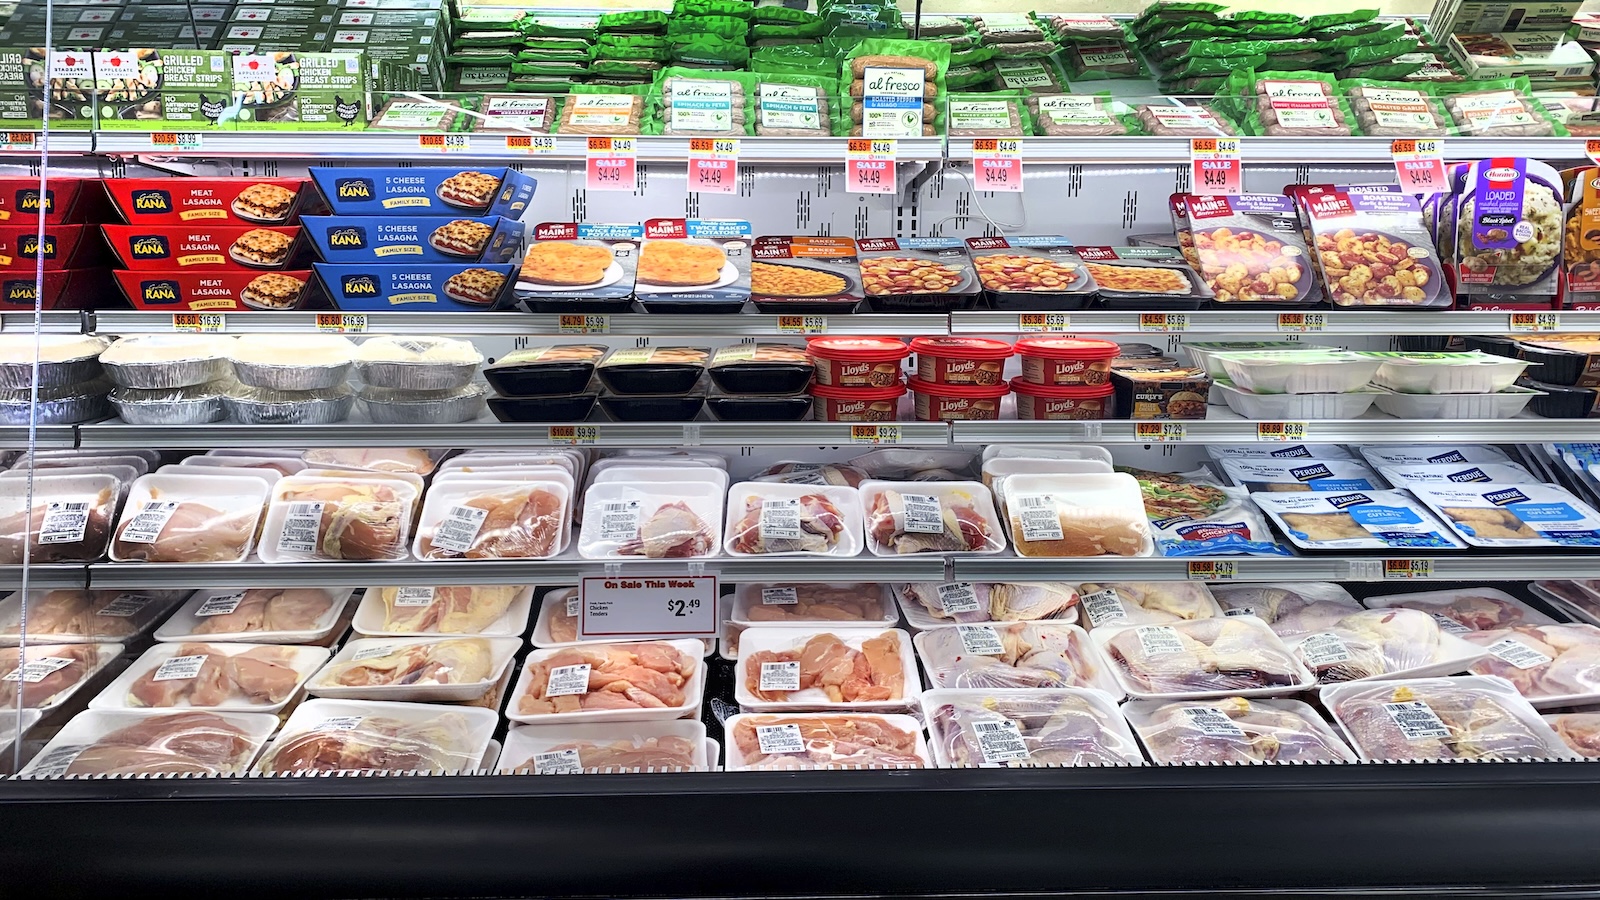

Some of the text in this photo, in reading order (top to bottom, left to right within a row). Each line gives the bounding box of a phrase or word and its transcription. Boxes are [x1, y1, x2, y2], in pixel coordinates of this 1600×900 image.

[164, 56, 203, 66] GRILLED
[300, 58, 338, 68] GRILLED
[164, 66, 196, 74] CHICKEN
[196, 75, 222, 83] STRIPS
[869, 76, 920, 90] al fresco
[154, 134, 196, 144] $20.55 $8.99
[422, 137, 464, 146] $10.65 $4.99
[510, 138, 552, 148] $10.65 $4.99
[614, 142, 631, 150] $4.49
[716, 143, 733, 152] $4.49
[873, 144, 890, 152] $4.49
[1000, 142, 1016, 151] $4.49
[1219, 143, 1235, 151] $4.49
[1418, 142, 1435, 152] $4.49
[598, 168, 620, 181] $4.49
[700, 170, 721, 183] $4.49
[859, 170, 880, 184] $4.49
[986, 169, 1007, 182] $4.49
[1205, 171, 1226, 185] $4.49
[1410, 170, 1432, 184] $4.49
[340, 186, 369, 197] RANA
[1486, 192, 1515, 200] LOADED
[137, 198, 166, 209] RANA
[1192, 202, 1217, 212] MAIN
[1313, 201, 1339, 212] MAIN
[331, 235, 361, 245] RANA
[134, 244, 164, 254] RANA
[346, 283, 375, 293] RANA
[146, 289, 175, 299] RANA
[176, 316, 220, 326] $6.80 $16.99
[320, 316, 364, 326] $6.80 $16.99
[562, 316, 604, 326] $4.79 $5.99
[782, 317, 823, 327] $4.55 $5.69
[1024, 316, 1064, 325] $5.36 $5.69
[1144, 316, 1185, 325] $4.55 $5.69
[1282, 315, 1323, 325] $5.36 $5.69
[1515, 314, 1556, 324] $3.99 $4.99
[842, 363, 869, 376] Lloyd's
[947, 361, 975, 373] Lloyd's
[1056, 361, 1084, 374] Lloyd's
[838, 402, 865, 414] Lloyd's
[940, 399, 968, 411] Lloyd's
[1046, 400, 1074, 412] Lloyd's
[578, 428, 596, 437] $9.99
[856, 428, 897, 437] $9.29 $9.29
[1141, 424, 1182, 434] $7.29 $7.29
[1262, 424, 1303, 433] $8.89 $8.89
[1294, 466, 1326, 478] PERDUE
[1452, 471, 1484, 482] PERDUE
[1331, 494, 1365, 504] PERDUE
[1487, 490, 1520, 502] PERDUE
[1215, 562, 1232, 572] $4.79
[1411, 561, 1428, 570] $5.19
[668, 599, 700, 617] $2.49
